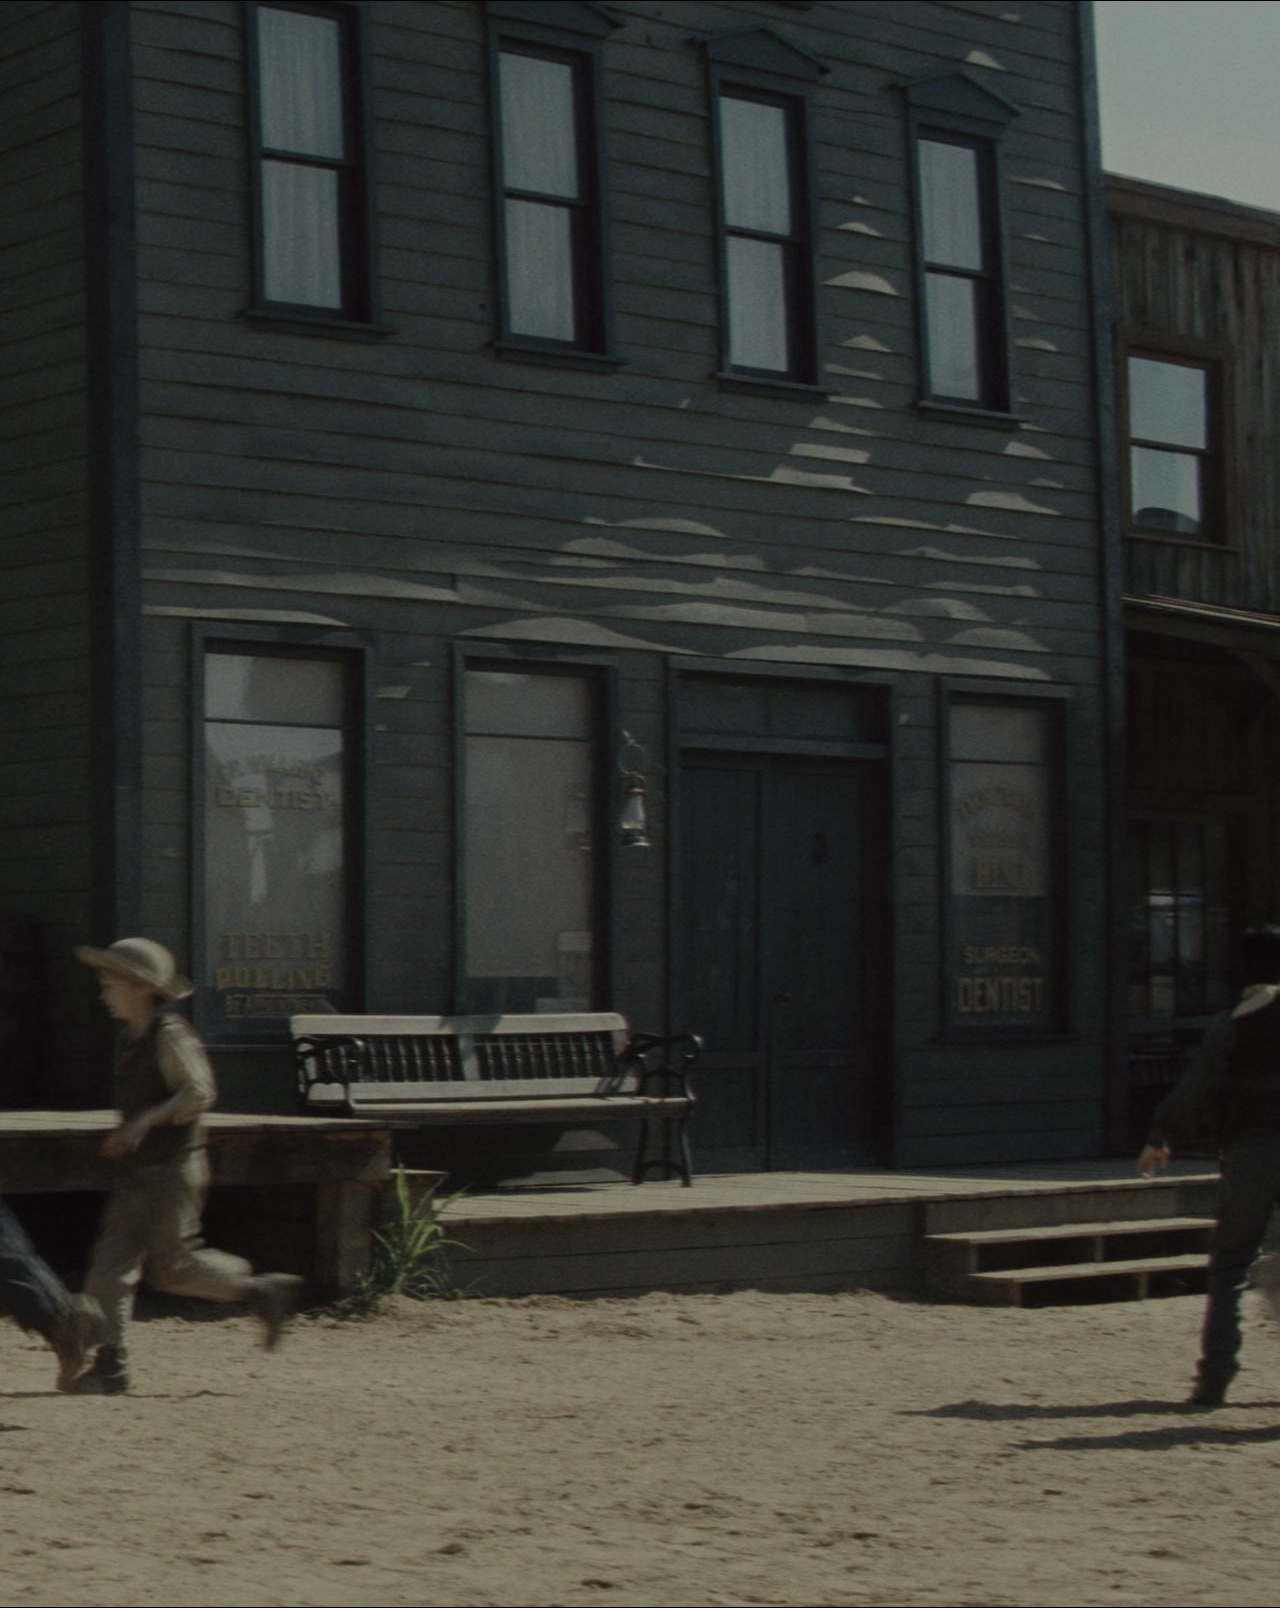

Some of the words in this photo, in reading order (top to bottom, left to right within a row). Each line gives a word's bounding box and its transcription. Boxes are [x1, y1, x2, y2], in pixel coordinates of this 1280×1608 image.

[221, 931, 331, 961] TEETH
[961, 944, 1041, 966] SURGEON
[214, 963, 331, 993] PULLING
[957, 976, 1046, 1014] DENTIST
